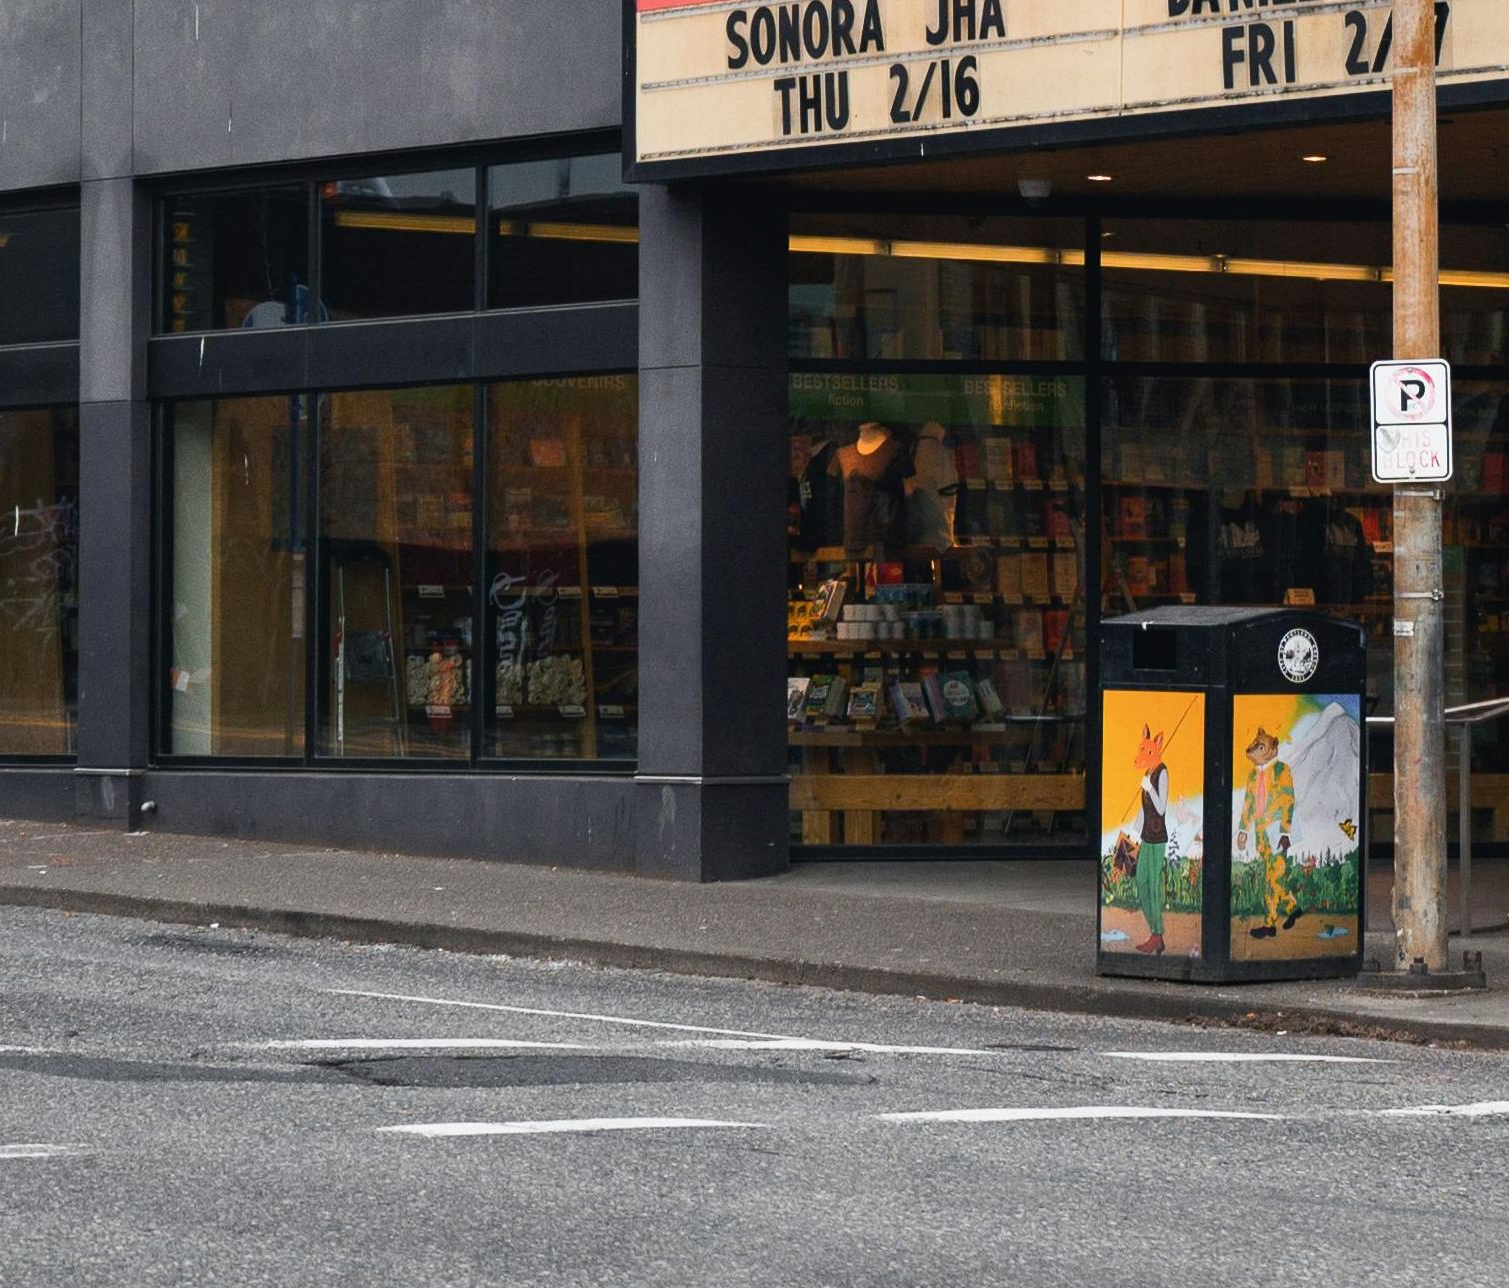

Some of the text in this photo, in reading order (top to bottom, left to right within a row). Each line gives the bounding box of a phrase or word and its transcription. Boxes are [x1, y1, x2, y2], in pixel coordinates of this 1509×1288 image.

[1221, 0, 1451, 90] FRI 2/7
[773, 57, 980, 136] THU 2/16
[792, 374, 898, 392] BESTSELLERS
[963, 379, 1068, 398] BESSELLERS
[1393, 429, 1432, 448] HIS
